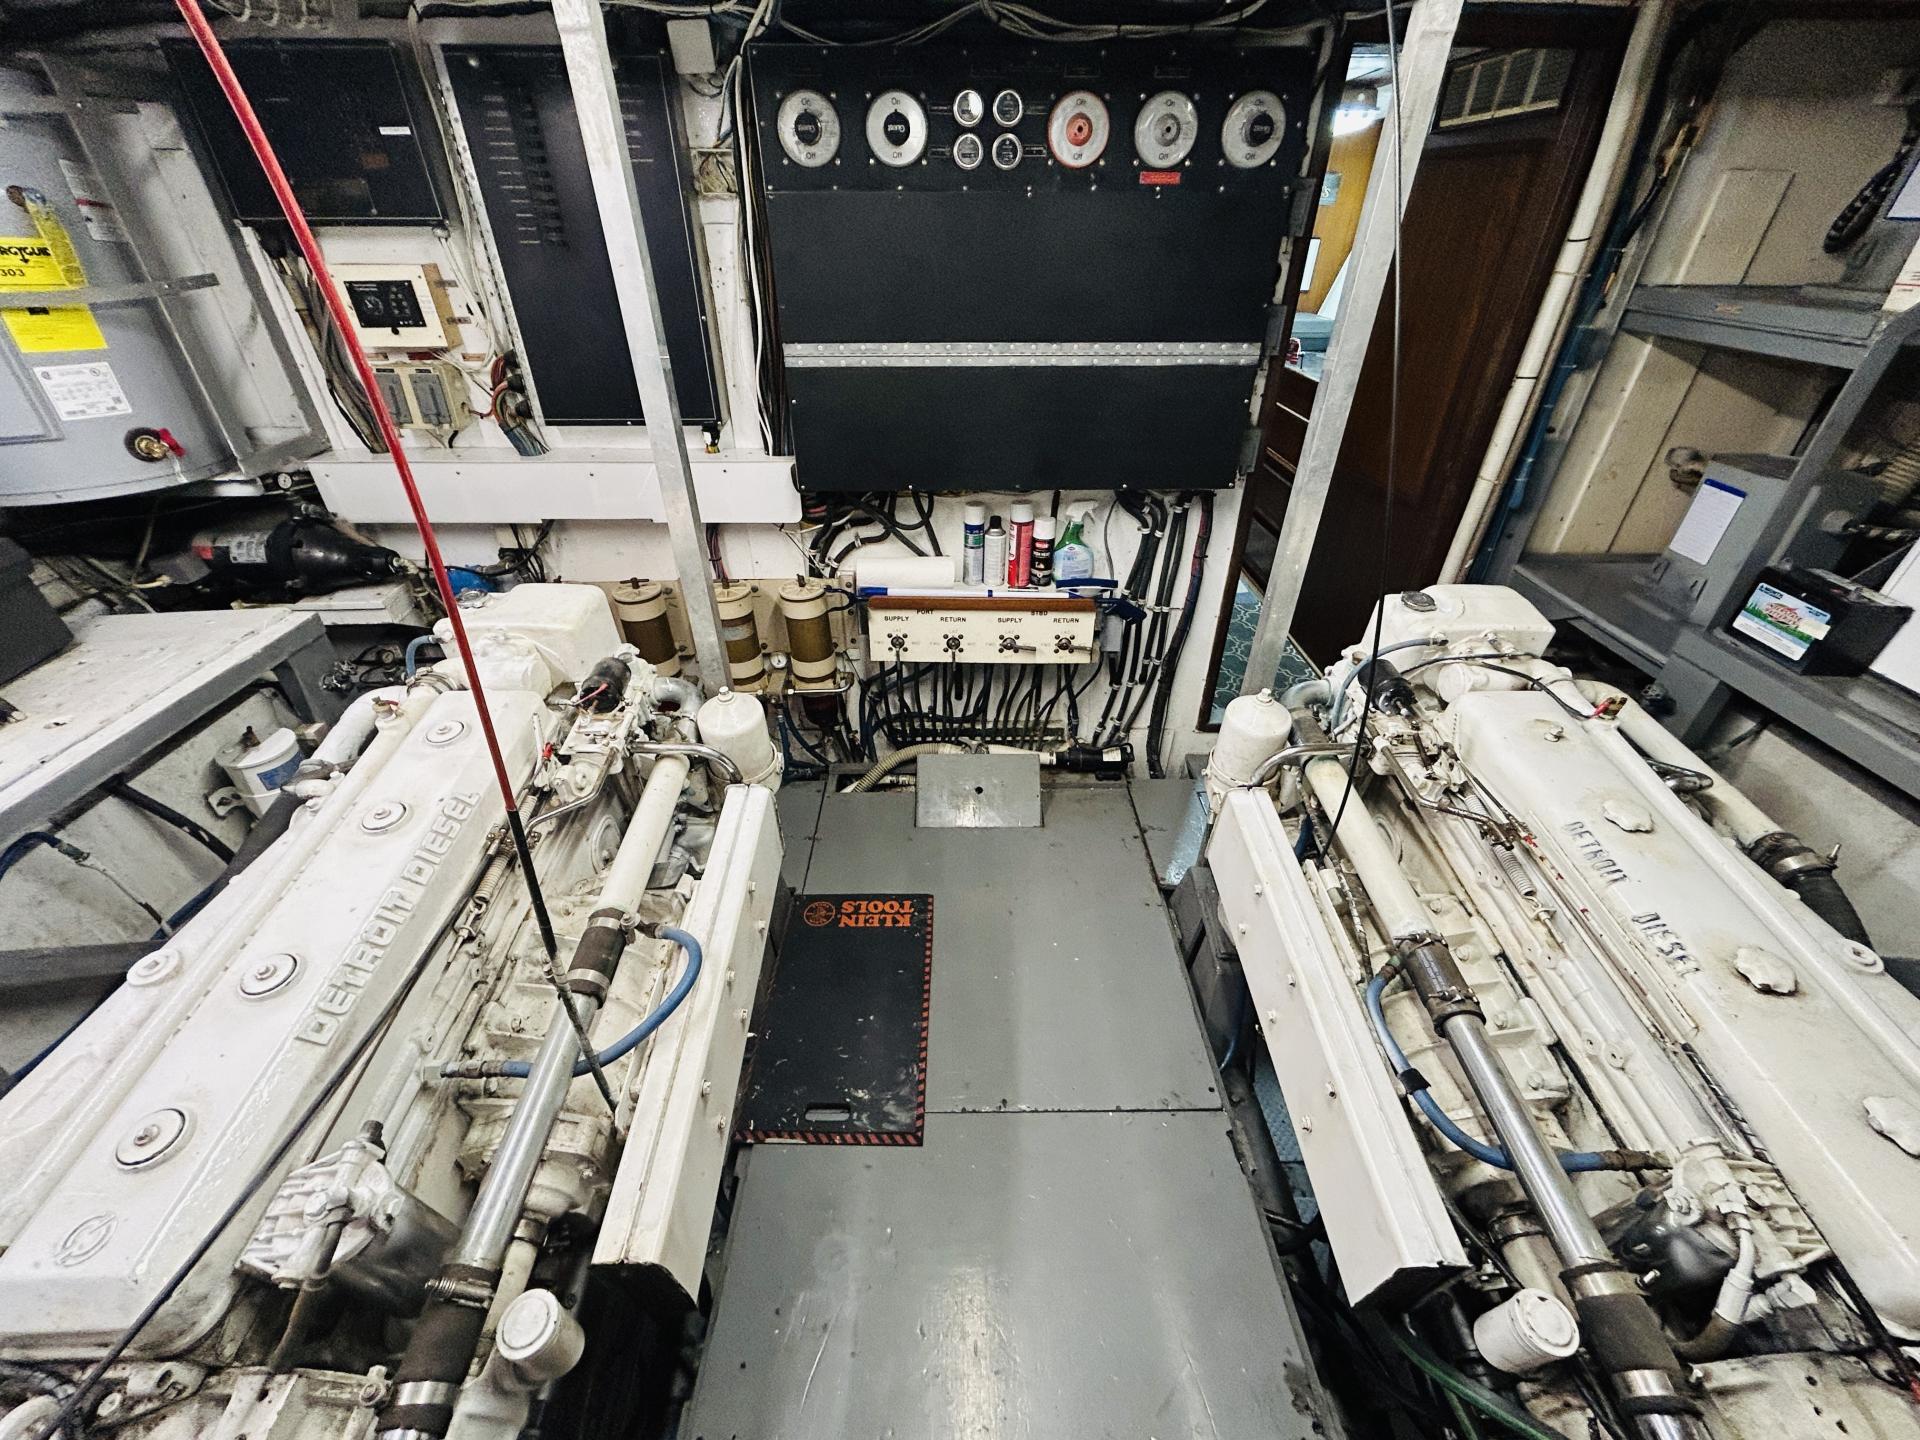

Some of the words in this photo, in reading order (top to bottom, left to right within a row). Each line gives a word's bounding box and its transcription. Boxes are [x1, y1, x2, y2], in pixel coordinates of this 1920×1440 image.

[806, 151, 816, 160] Off
[892, 151, 903, 160] Off
[1073, 152, 1083, 161] Off
[1158, 152, 1169, 161] Off
[1245, 152, 1256, 161] Off
[916, 608, 935, 616] PORT
[841, 900, 915, 914] TOOLS
[294, 886, 416, 1046] DETROIT
[400, 791, 481, 886] DIESEL
[838, 914, 912, 928] KLEIN
